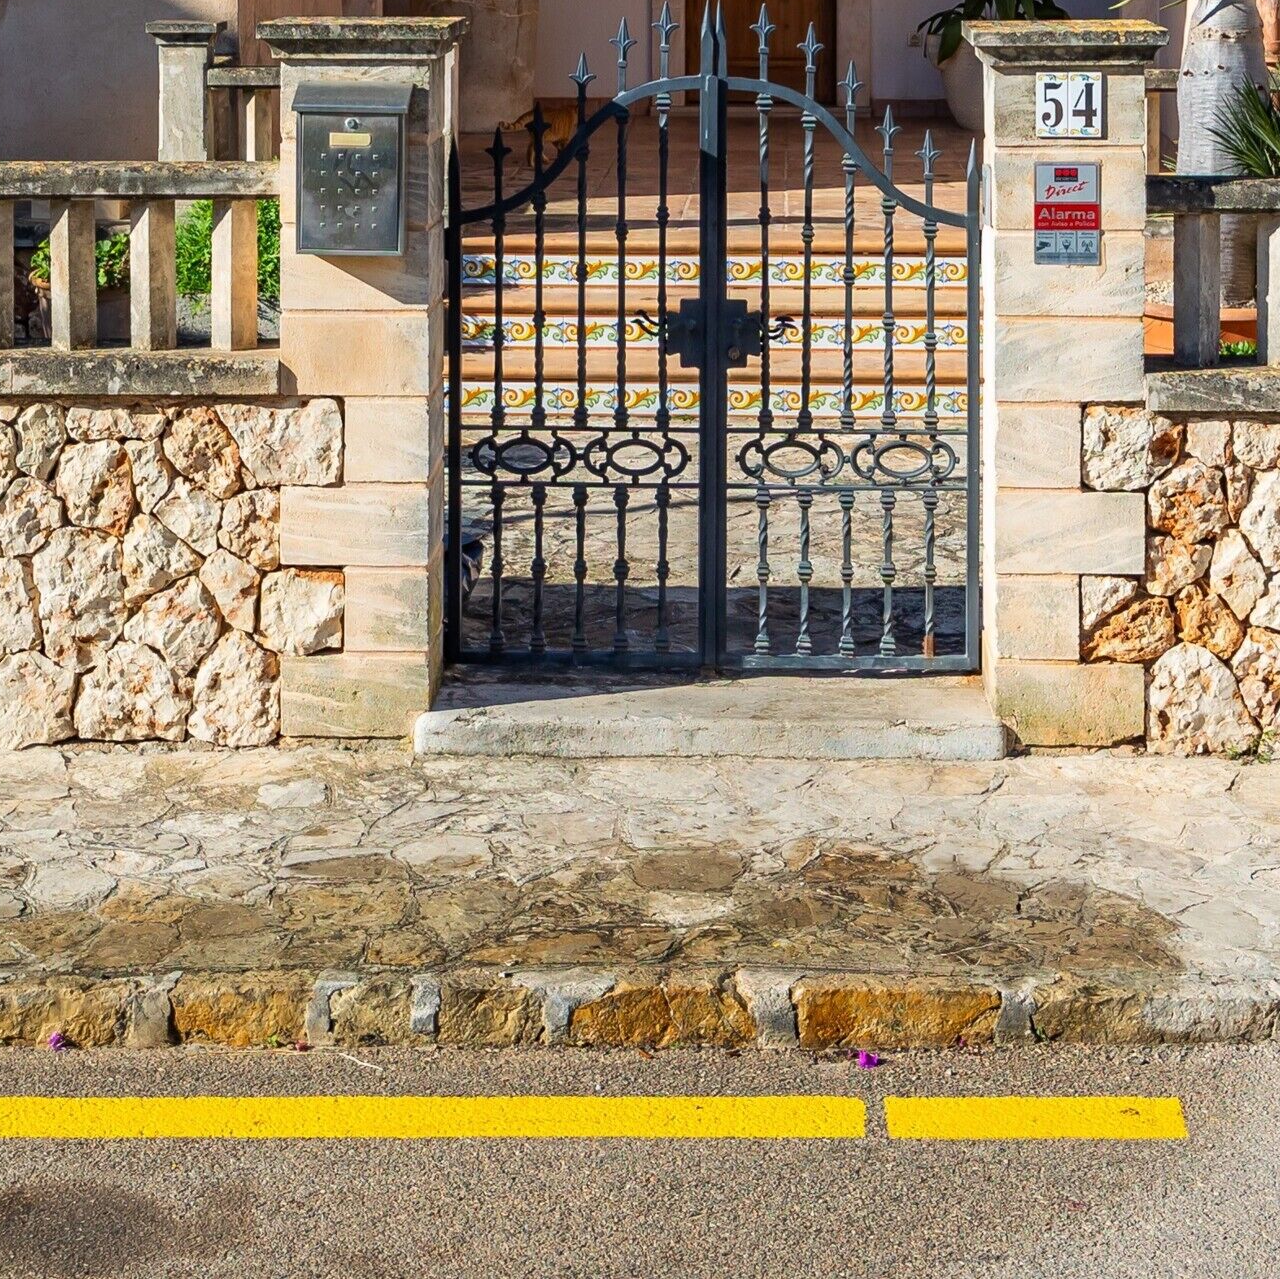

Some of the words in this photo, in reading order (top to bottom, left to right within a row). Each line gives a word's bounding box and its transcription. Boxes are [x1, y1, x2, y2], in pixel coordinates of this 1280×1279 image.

[1042, 82, 1098, 128] 54
[1045, 181, 1089, 200] Direct
[1038, 207, 1096, 220] Alarma
